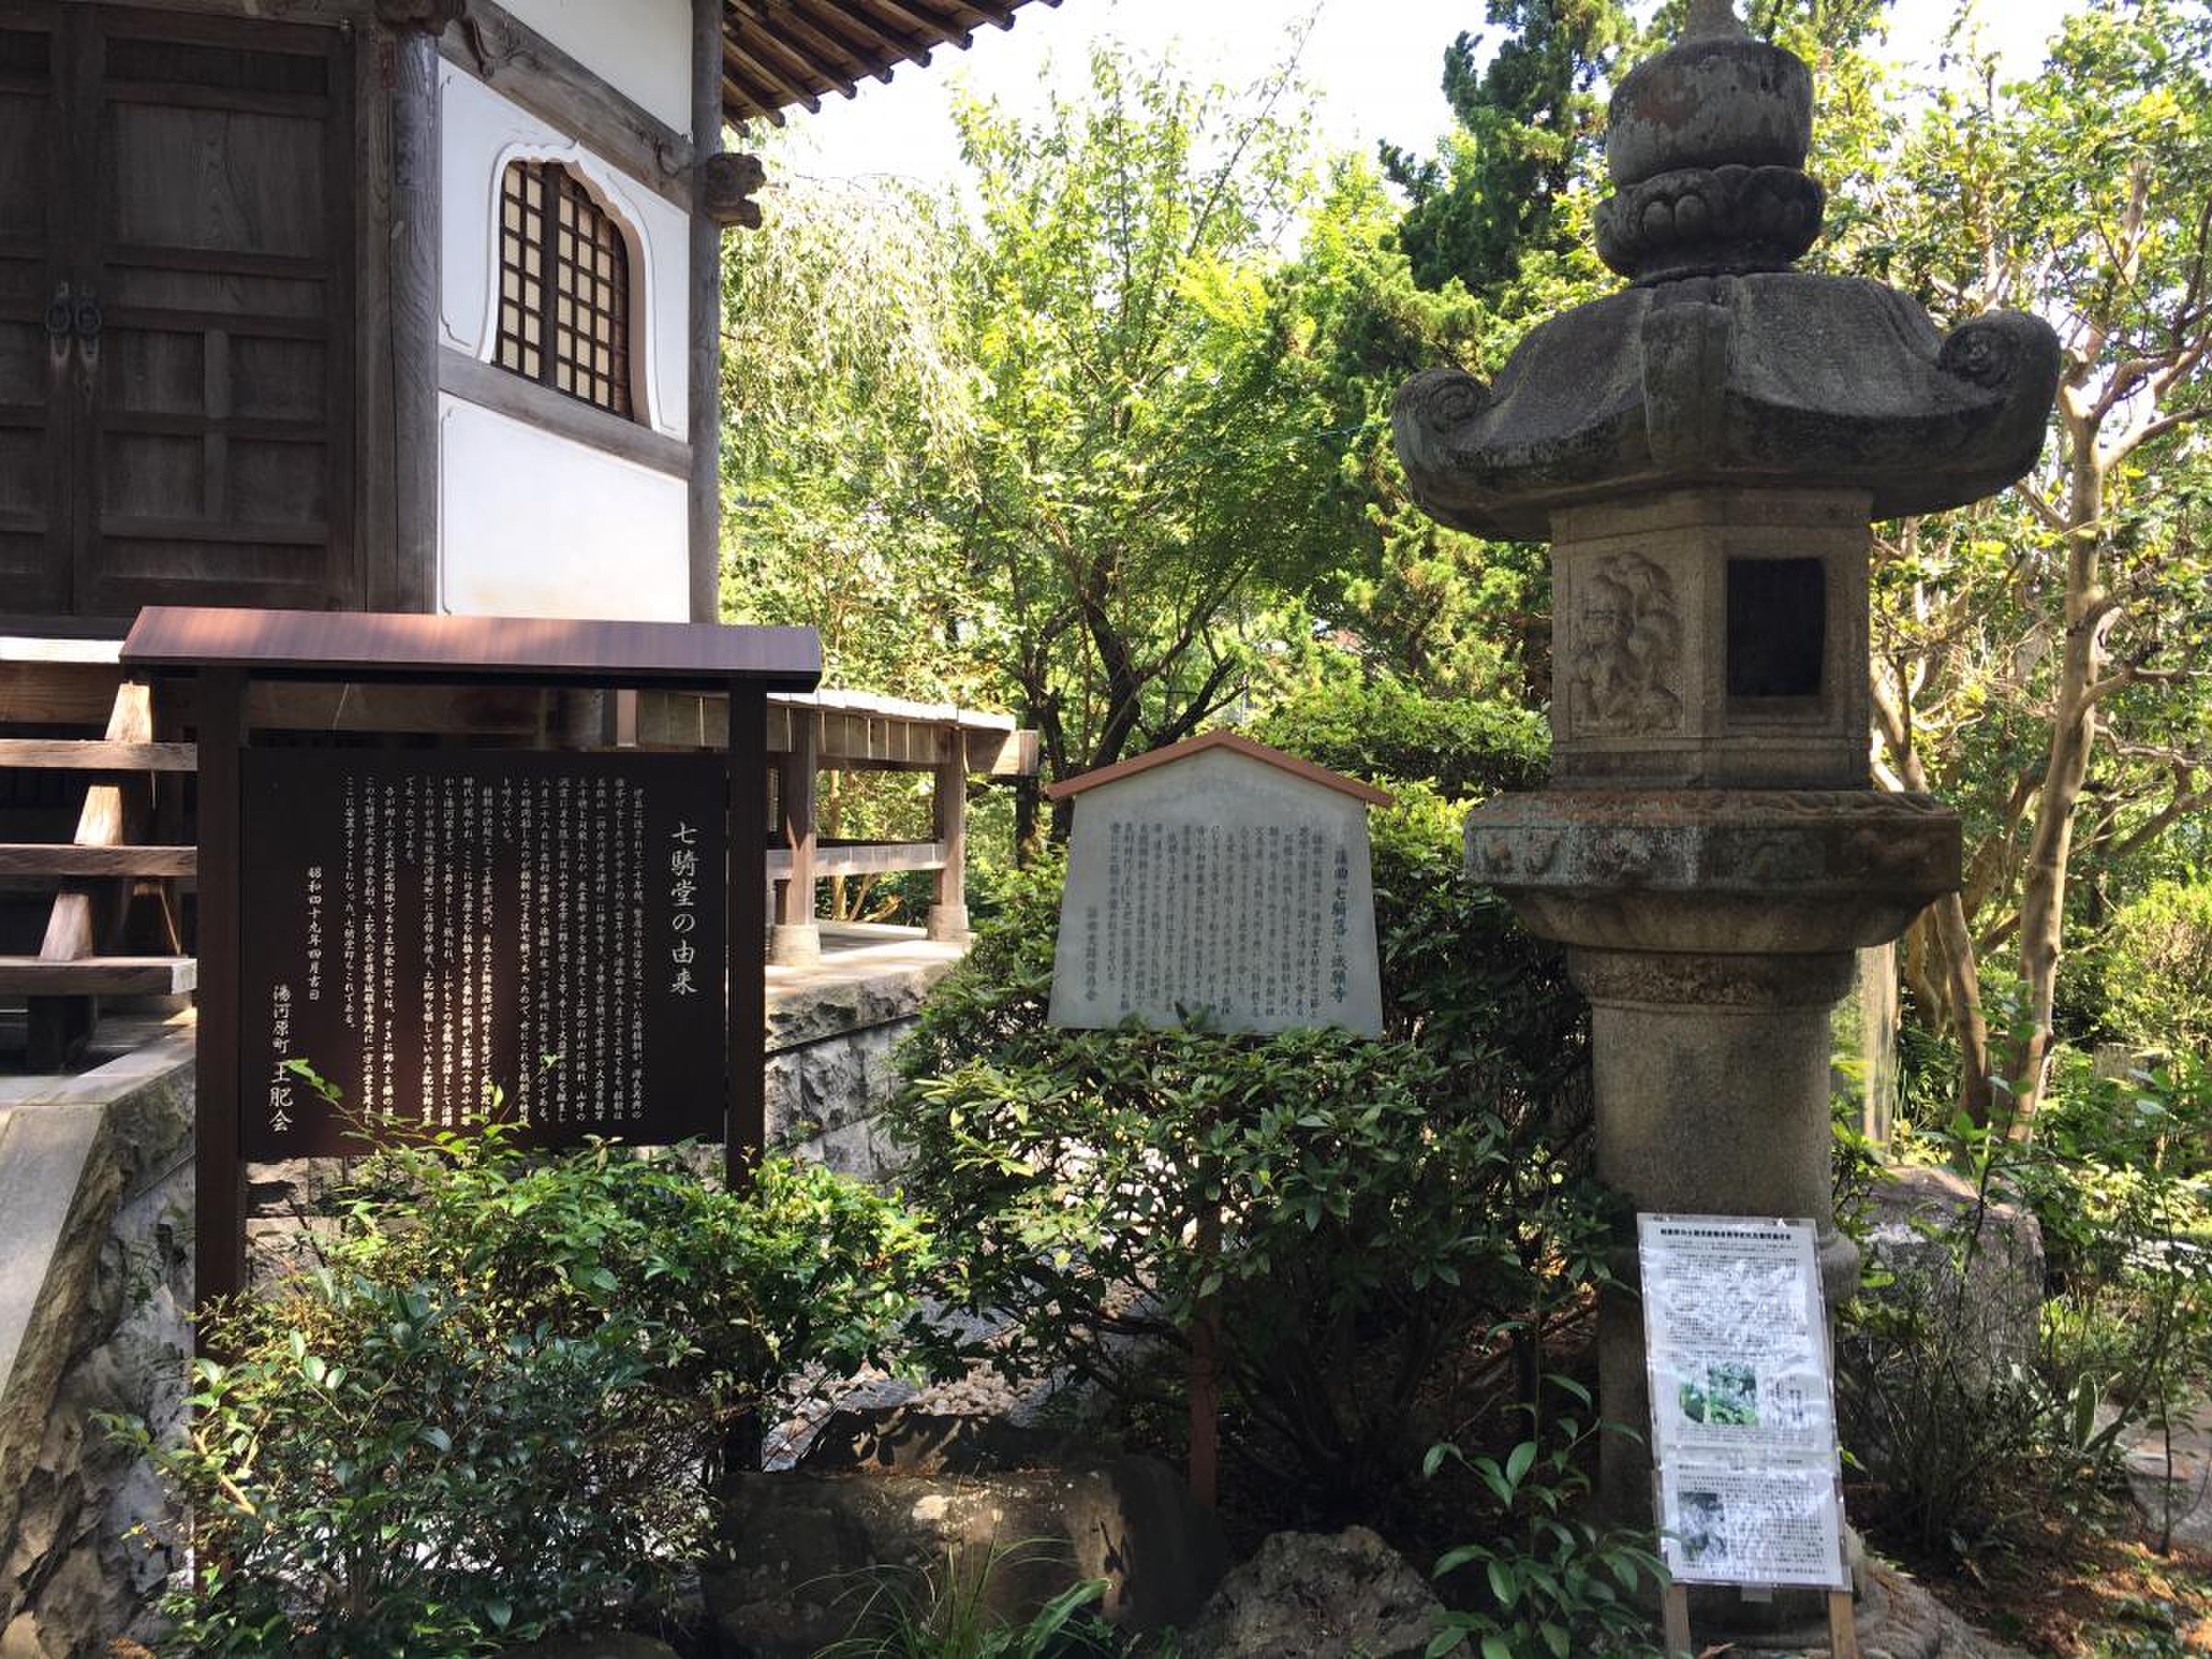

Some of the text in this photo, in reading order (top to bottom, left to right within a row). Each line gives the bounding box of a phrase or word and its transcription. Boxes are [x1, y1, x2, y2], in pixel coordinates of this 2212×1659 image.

[307, 866, 323, 1001] 昭和四十九年四月吉日
[670, 821, 698, 995] 七騎堂の由来
[268, 983, 294, 1132] 湯河原町 土肥会
